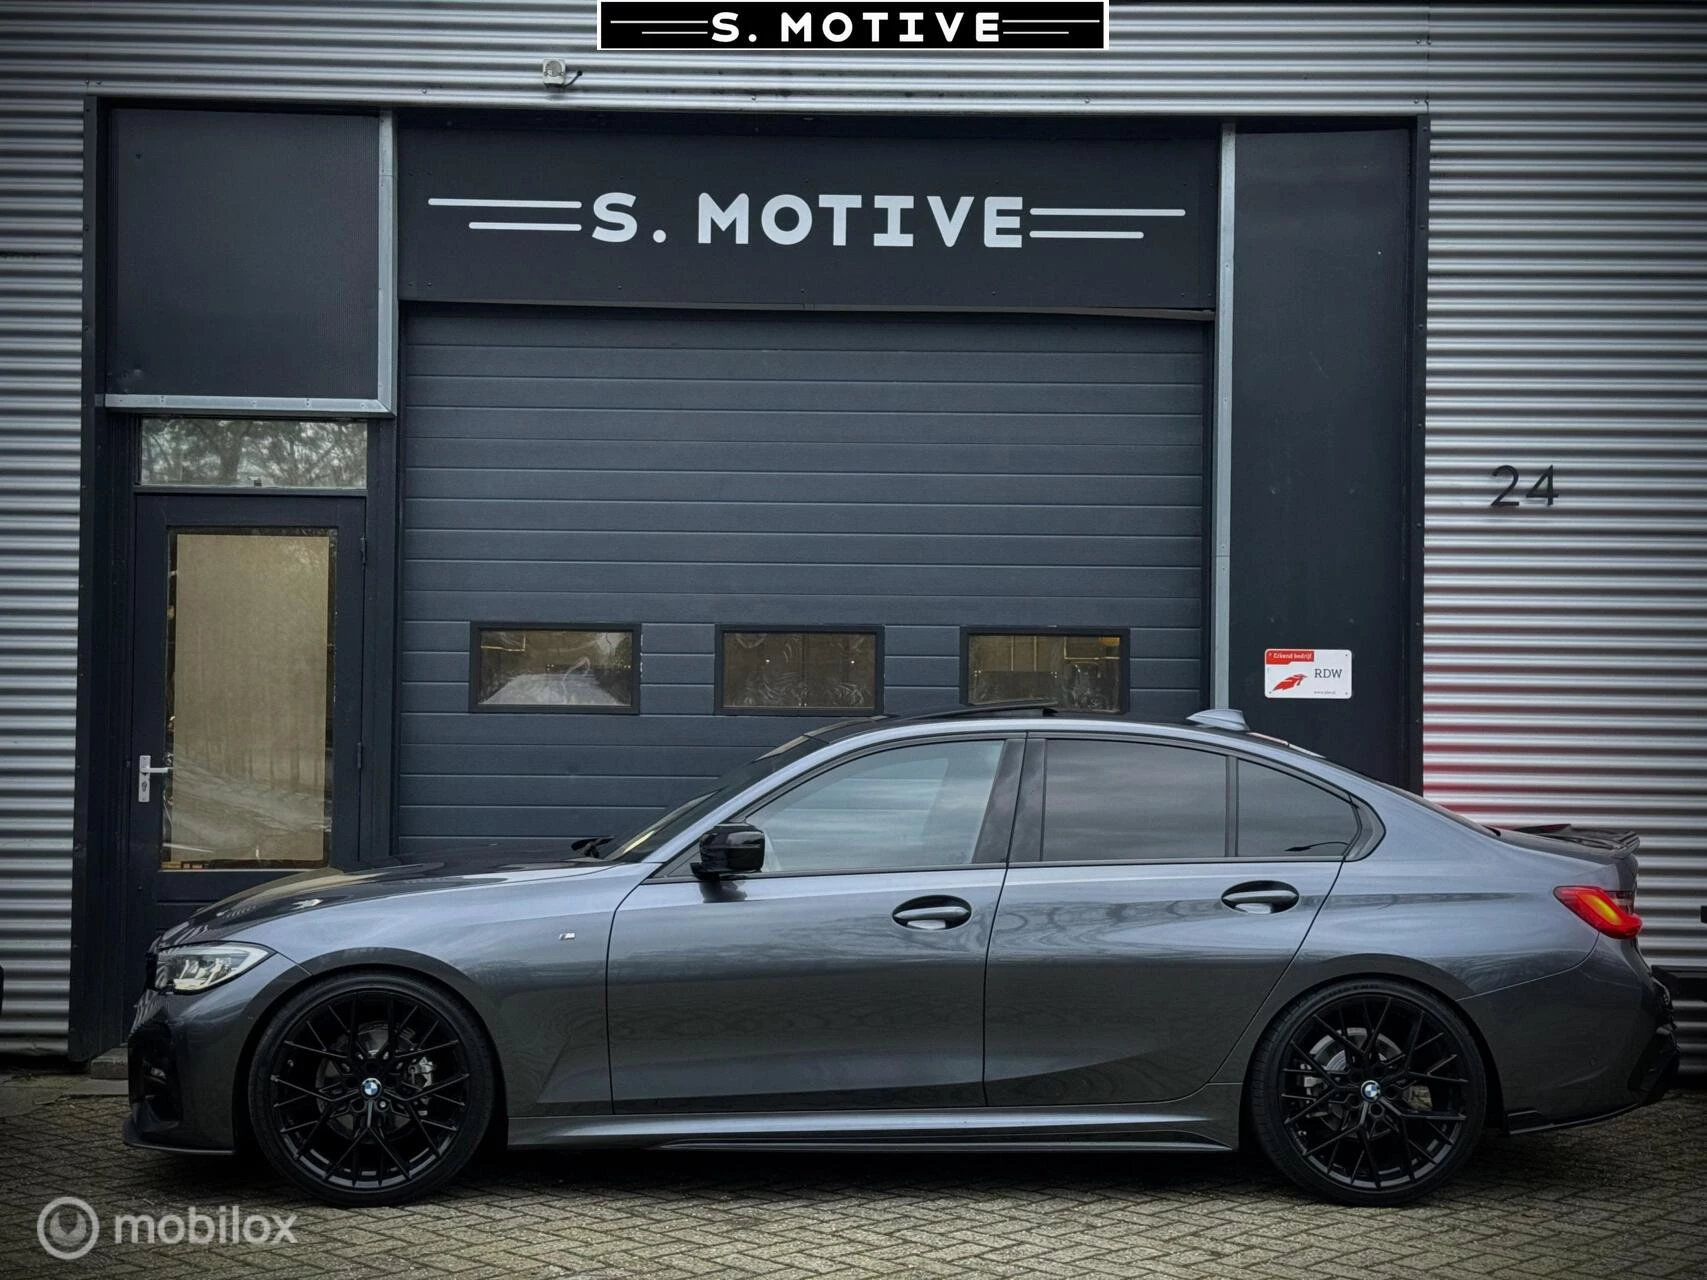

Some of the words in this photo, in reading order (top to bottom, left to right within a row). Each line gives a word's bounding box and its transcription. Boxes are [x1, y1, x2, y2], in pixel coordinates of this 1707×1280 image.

[592, 192, 667, 244] S.
[698, 193, 1023, 249] MOTIVE
[1491, 465, 1559, 507] 24
[1314, 668, 1343, 679] RDW
